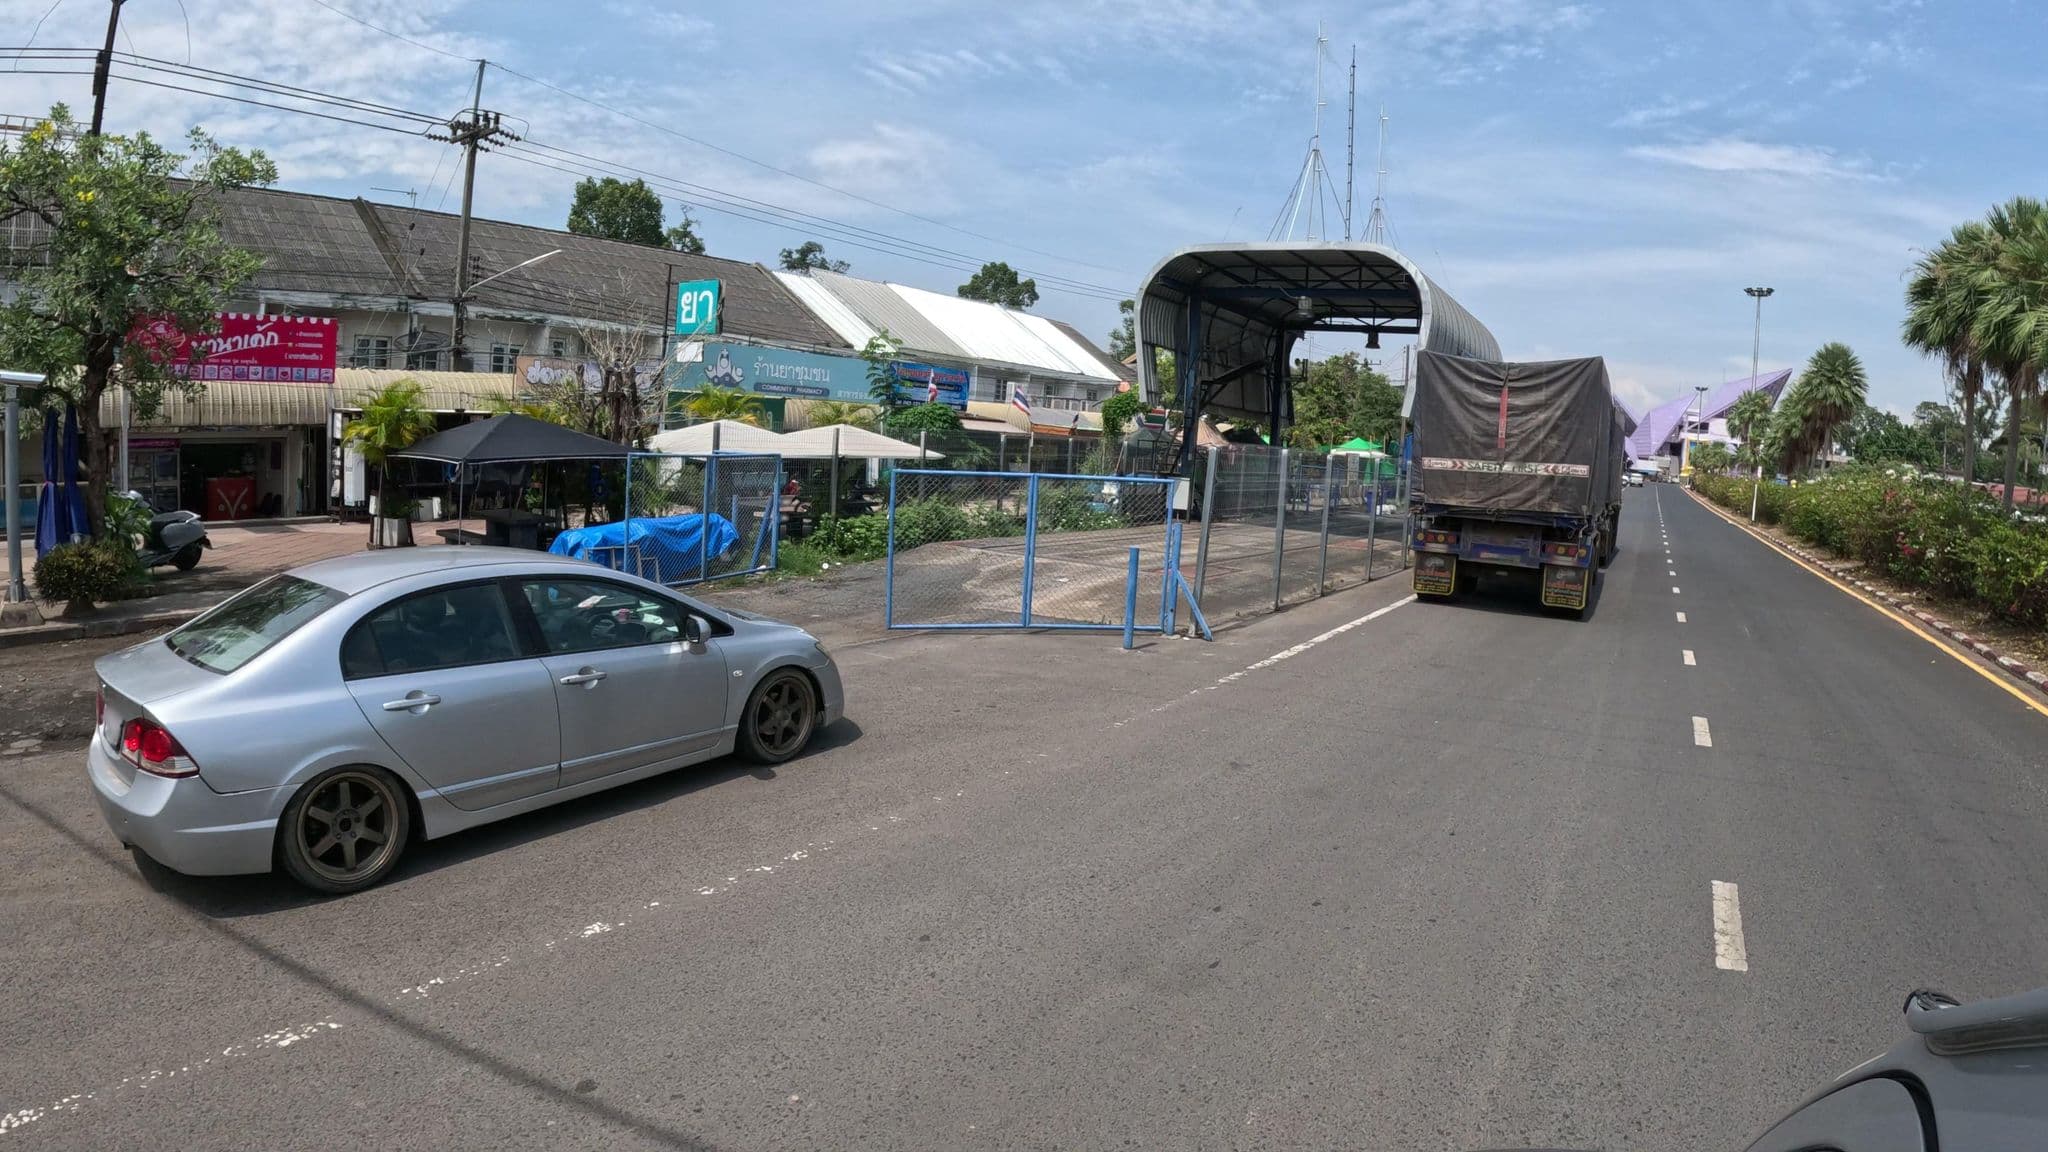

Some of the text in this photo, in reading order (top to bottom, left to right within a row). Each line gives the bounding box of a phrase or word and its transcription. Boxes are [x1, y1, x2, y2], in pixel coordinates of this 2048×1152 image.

[681, 290, 714, 324] ยา
[754, 356, 831, 386] ร้านยาชุมชน
[761, 383, 823, 396] COMMUNITY PHARMACY
[1467, 460, 1538, 474] SAFETY FIRST
